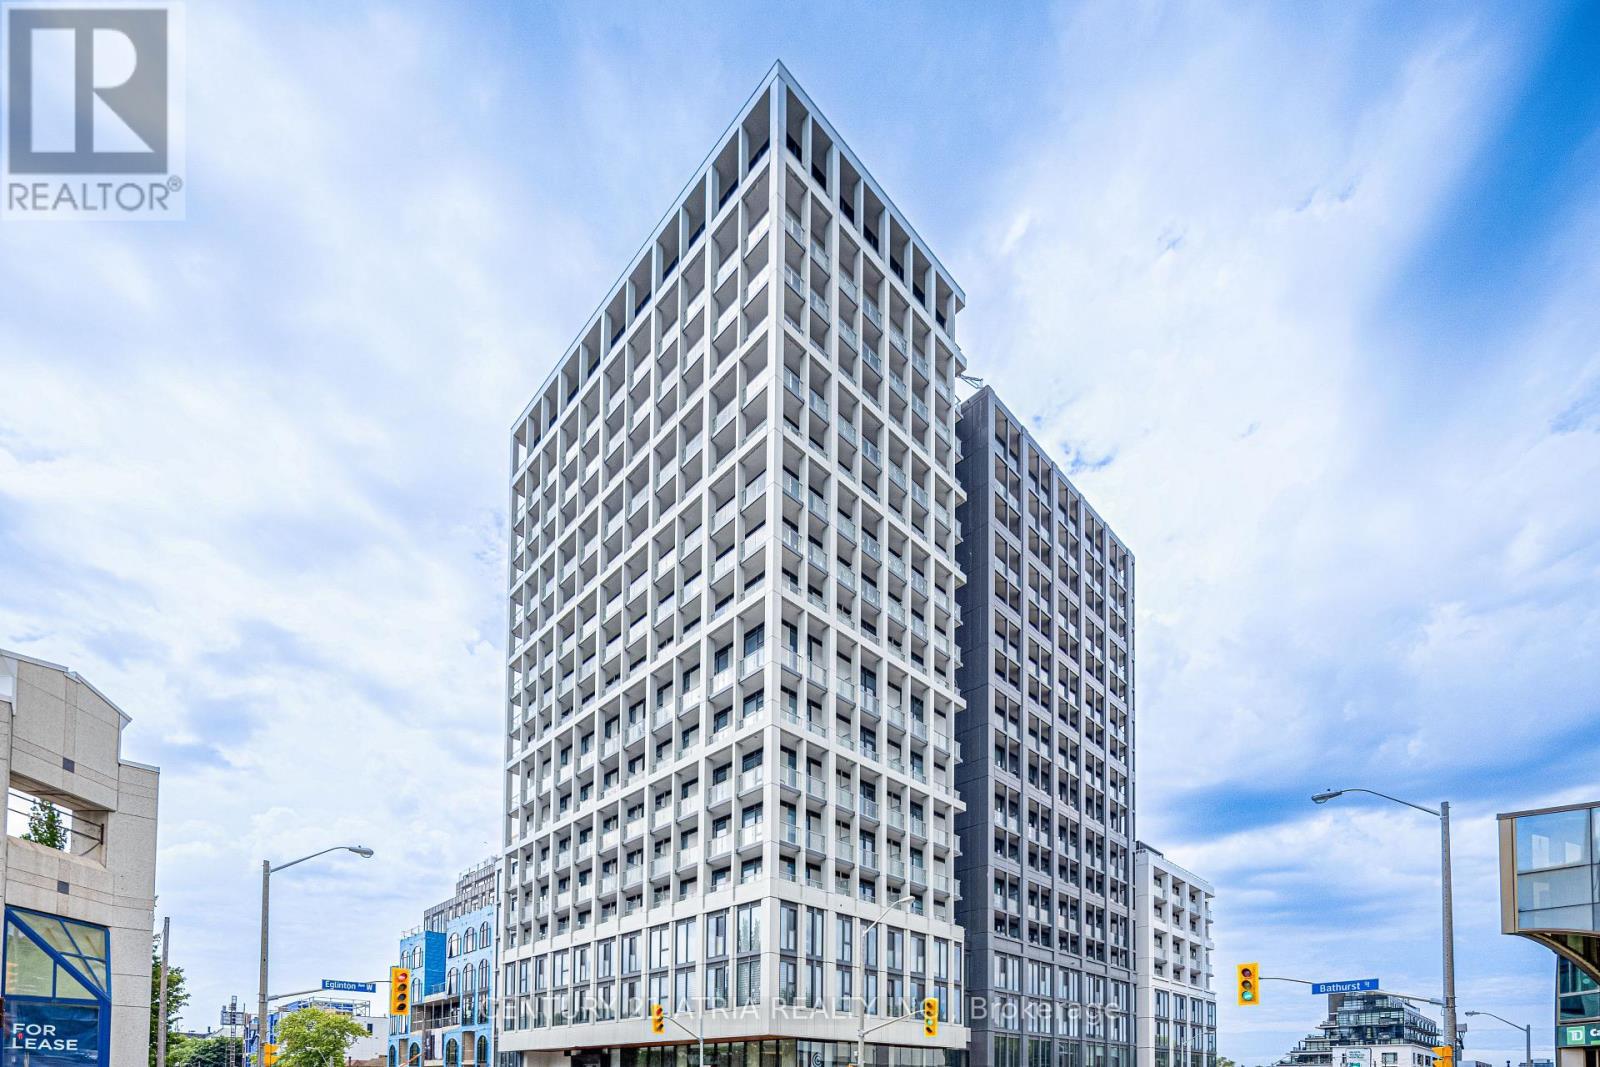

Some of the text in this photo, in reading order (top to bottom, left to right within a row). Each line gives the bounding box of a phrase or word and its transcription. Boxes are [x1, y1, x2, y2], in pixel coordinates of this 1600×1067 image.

[325, 980, 356, 990] Eglinton
[1320, 982, 1361, 993] Bathurst
[13, 1023, 56, 1036] FOR
[1569, 1030, 1583, 1041] TD
[12, 1037, 78, 1051] LEASE
